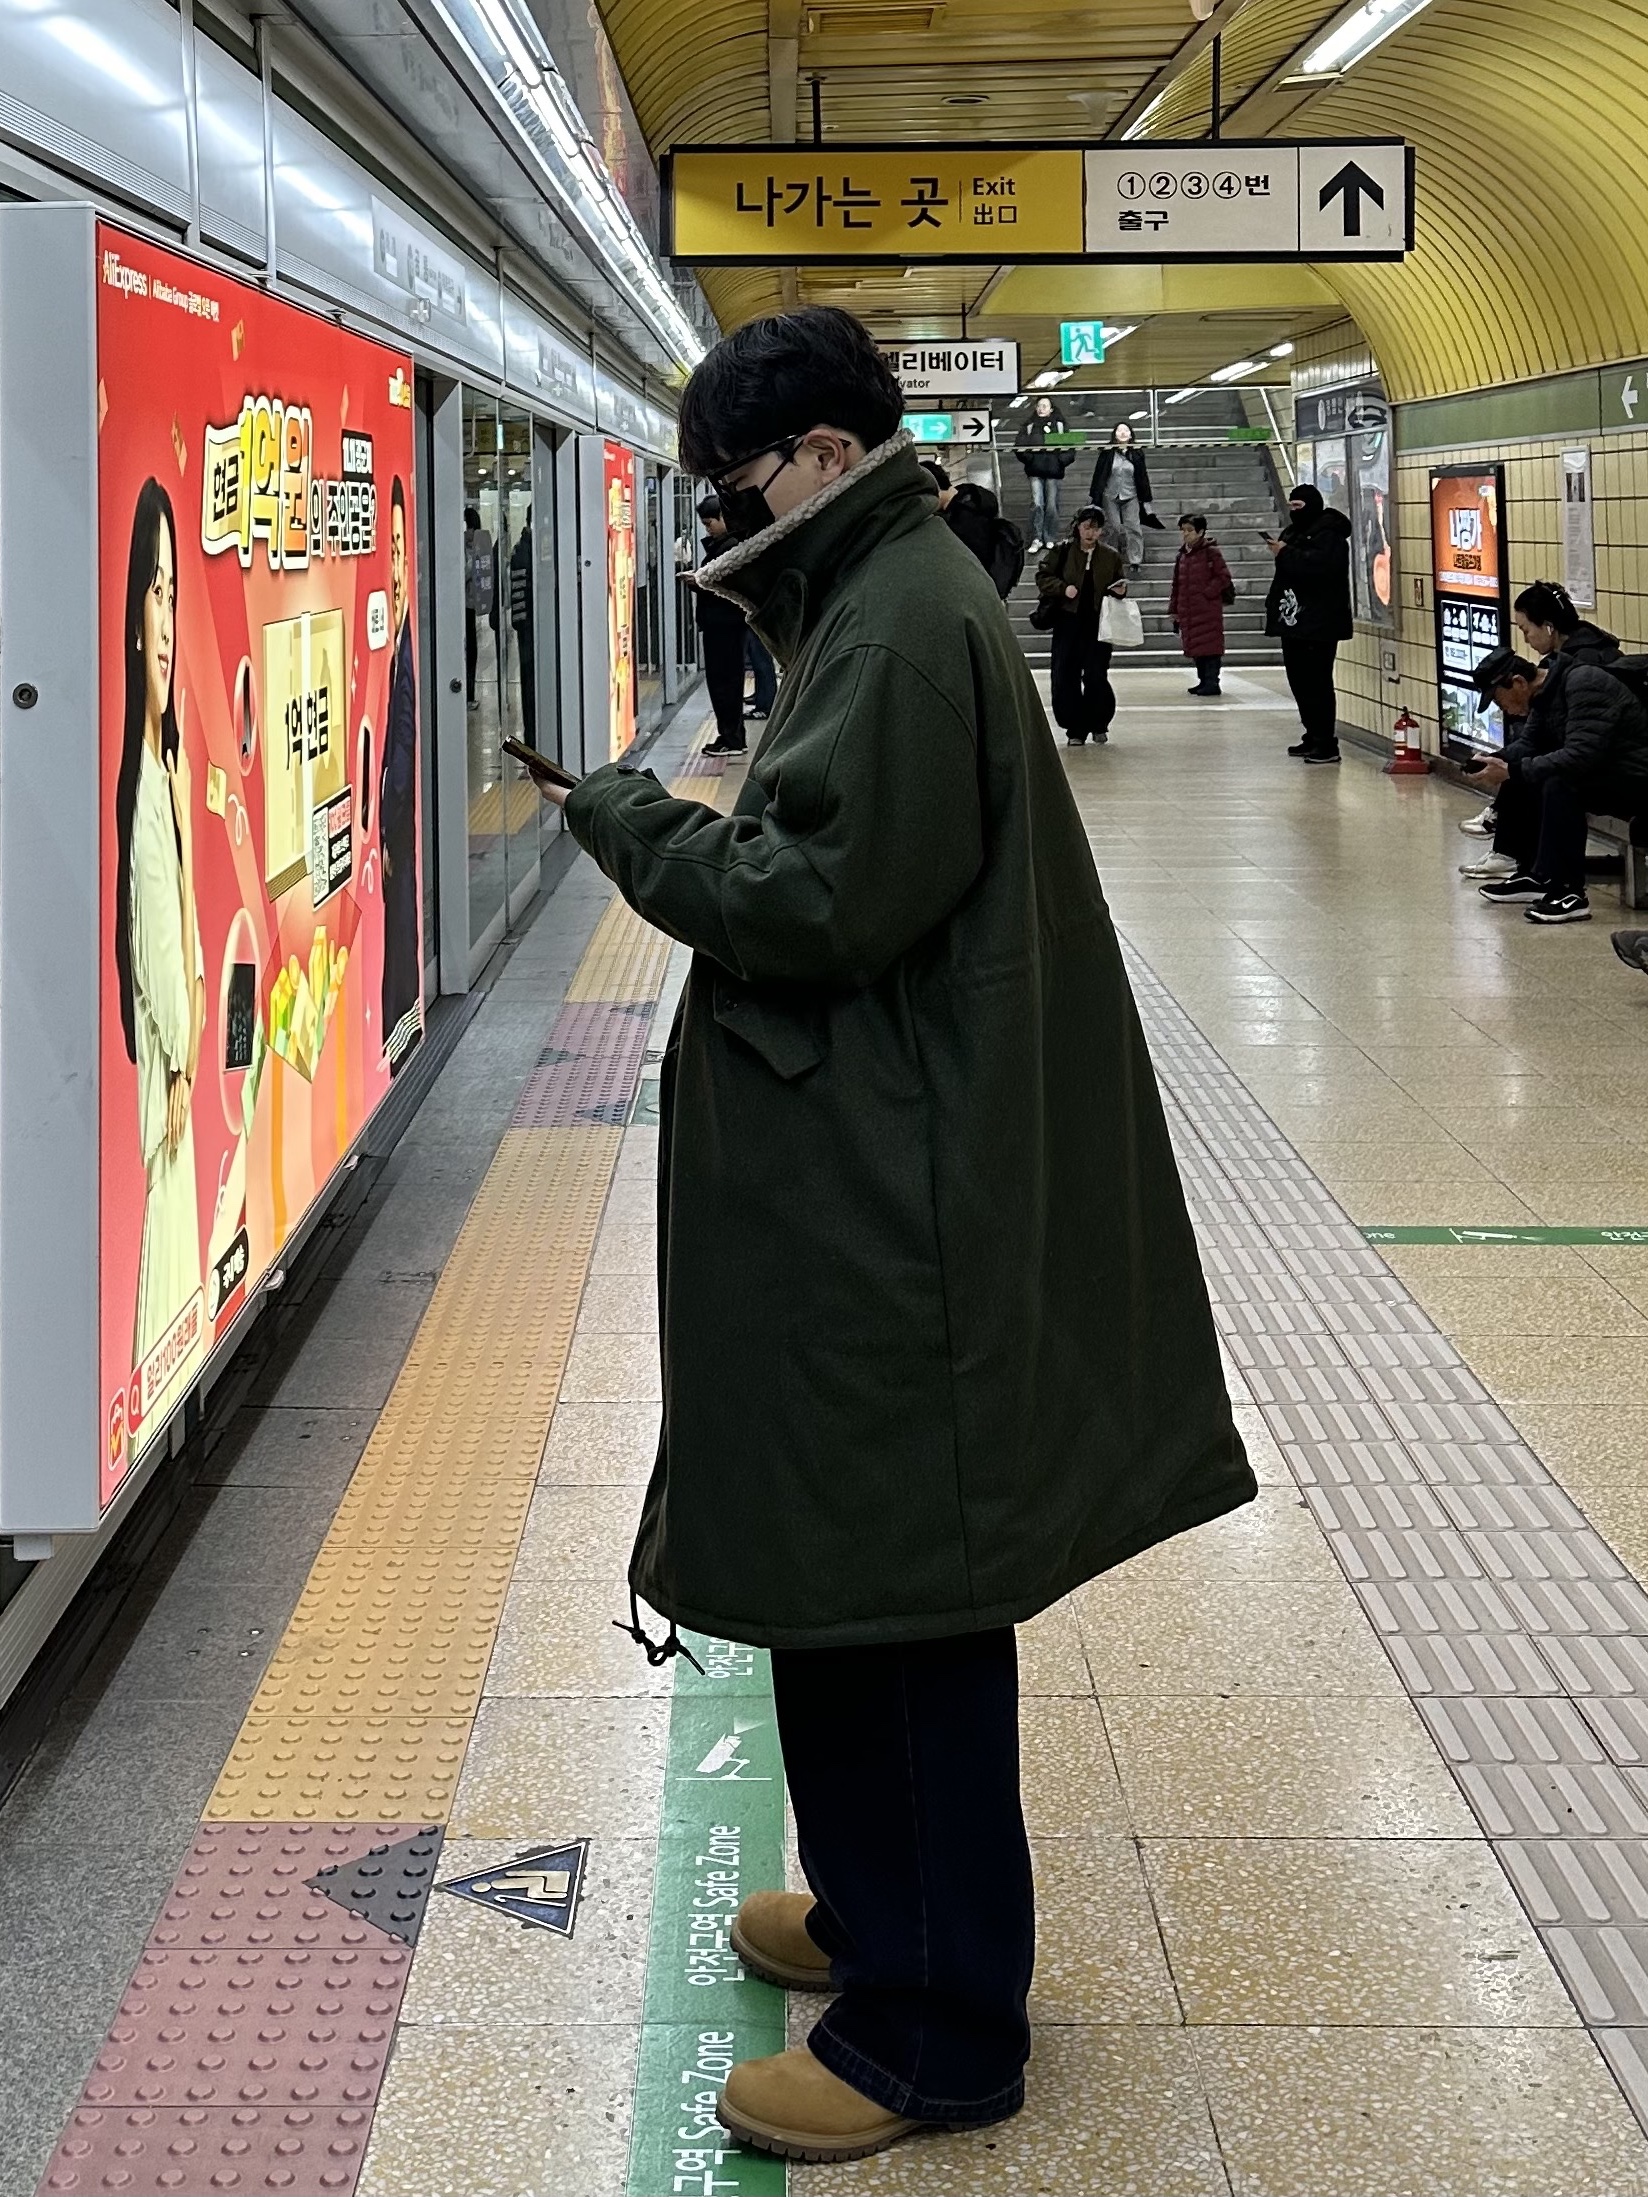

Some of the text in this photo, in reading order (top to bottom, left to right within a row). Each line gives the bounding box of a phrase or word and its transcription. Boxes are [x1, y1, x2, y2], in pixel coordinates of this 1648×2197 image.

[736, 176, 949, 229] 나가는 곳
[972, 176, 1016, 196] Exit
[1117, 171, 1271, 200] ①②③④번
[973, 203, 1018, 226] 出口
[1118, 210, 1169, 232] 출구
[103, 249, 148, 300] AliExpress
[899, 378, 931, 389] vator
[213, 454, 240, 523] 현금
[326, 480, 377, 557] 주인공은?
[284, 686, 329, 771] 1억 현금
[695, 1825, 741, 1867] Zone
[692, 1870, 740, 1908] Safe
[681, 2031, 734, 2084] Zone
[671, 2148, 742, 2197] 구역
